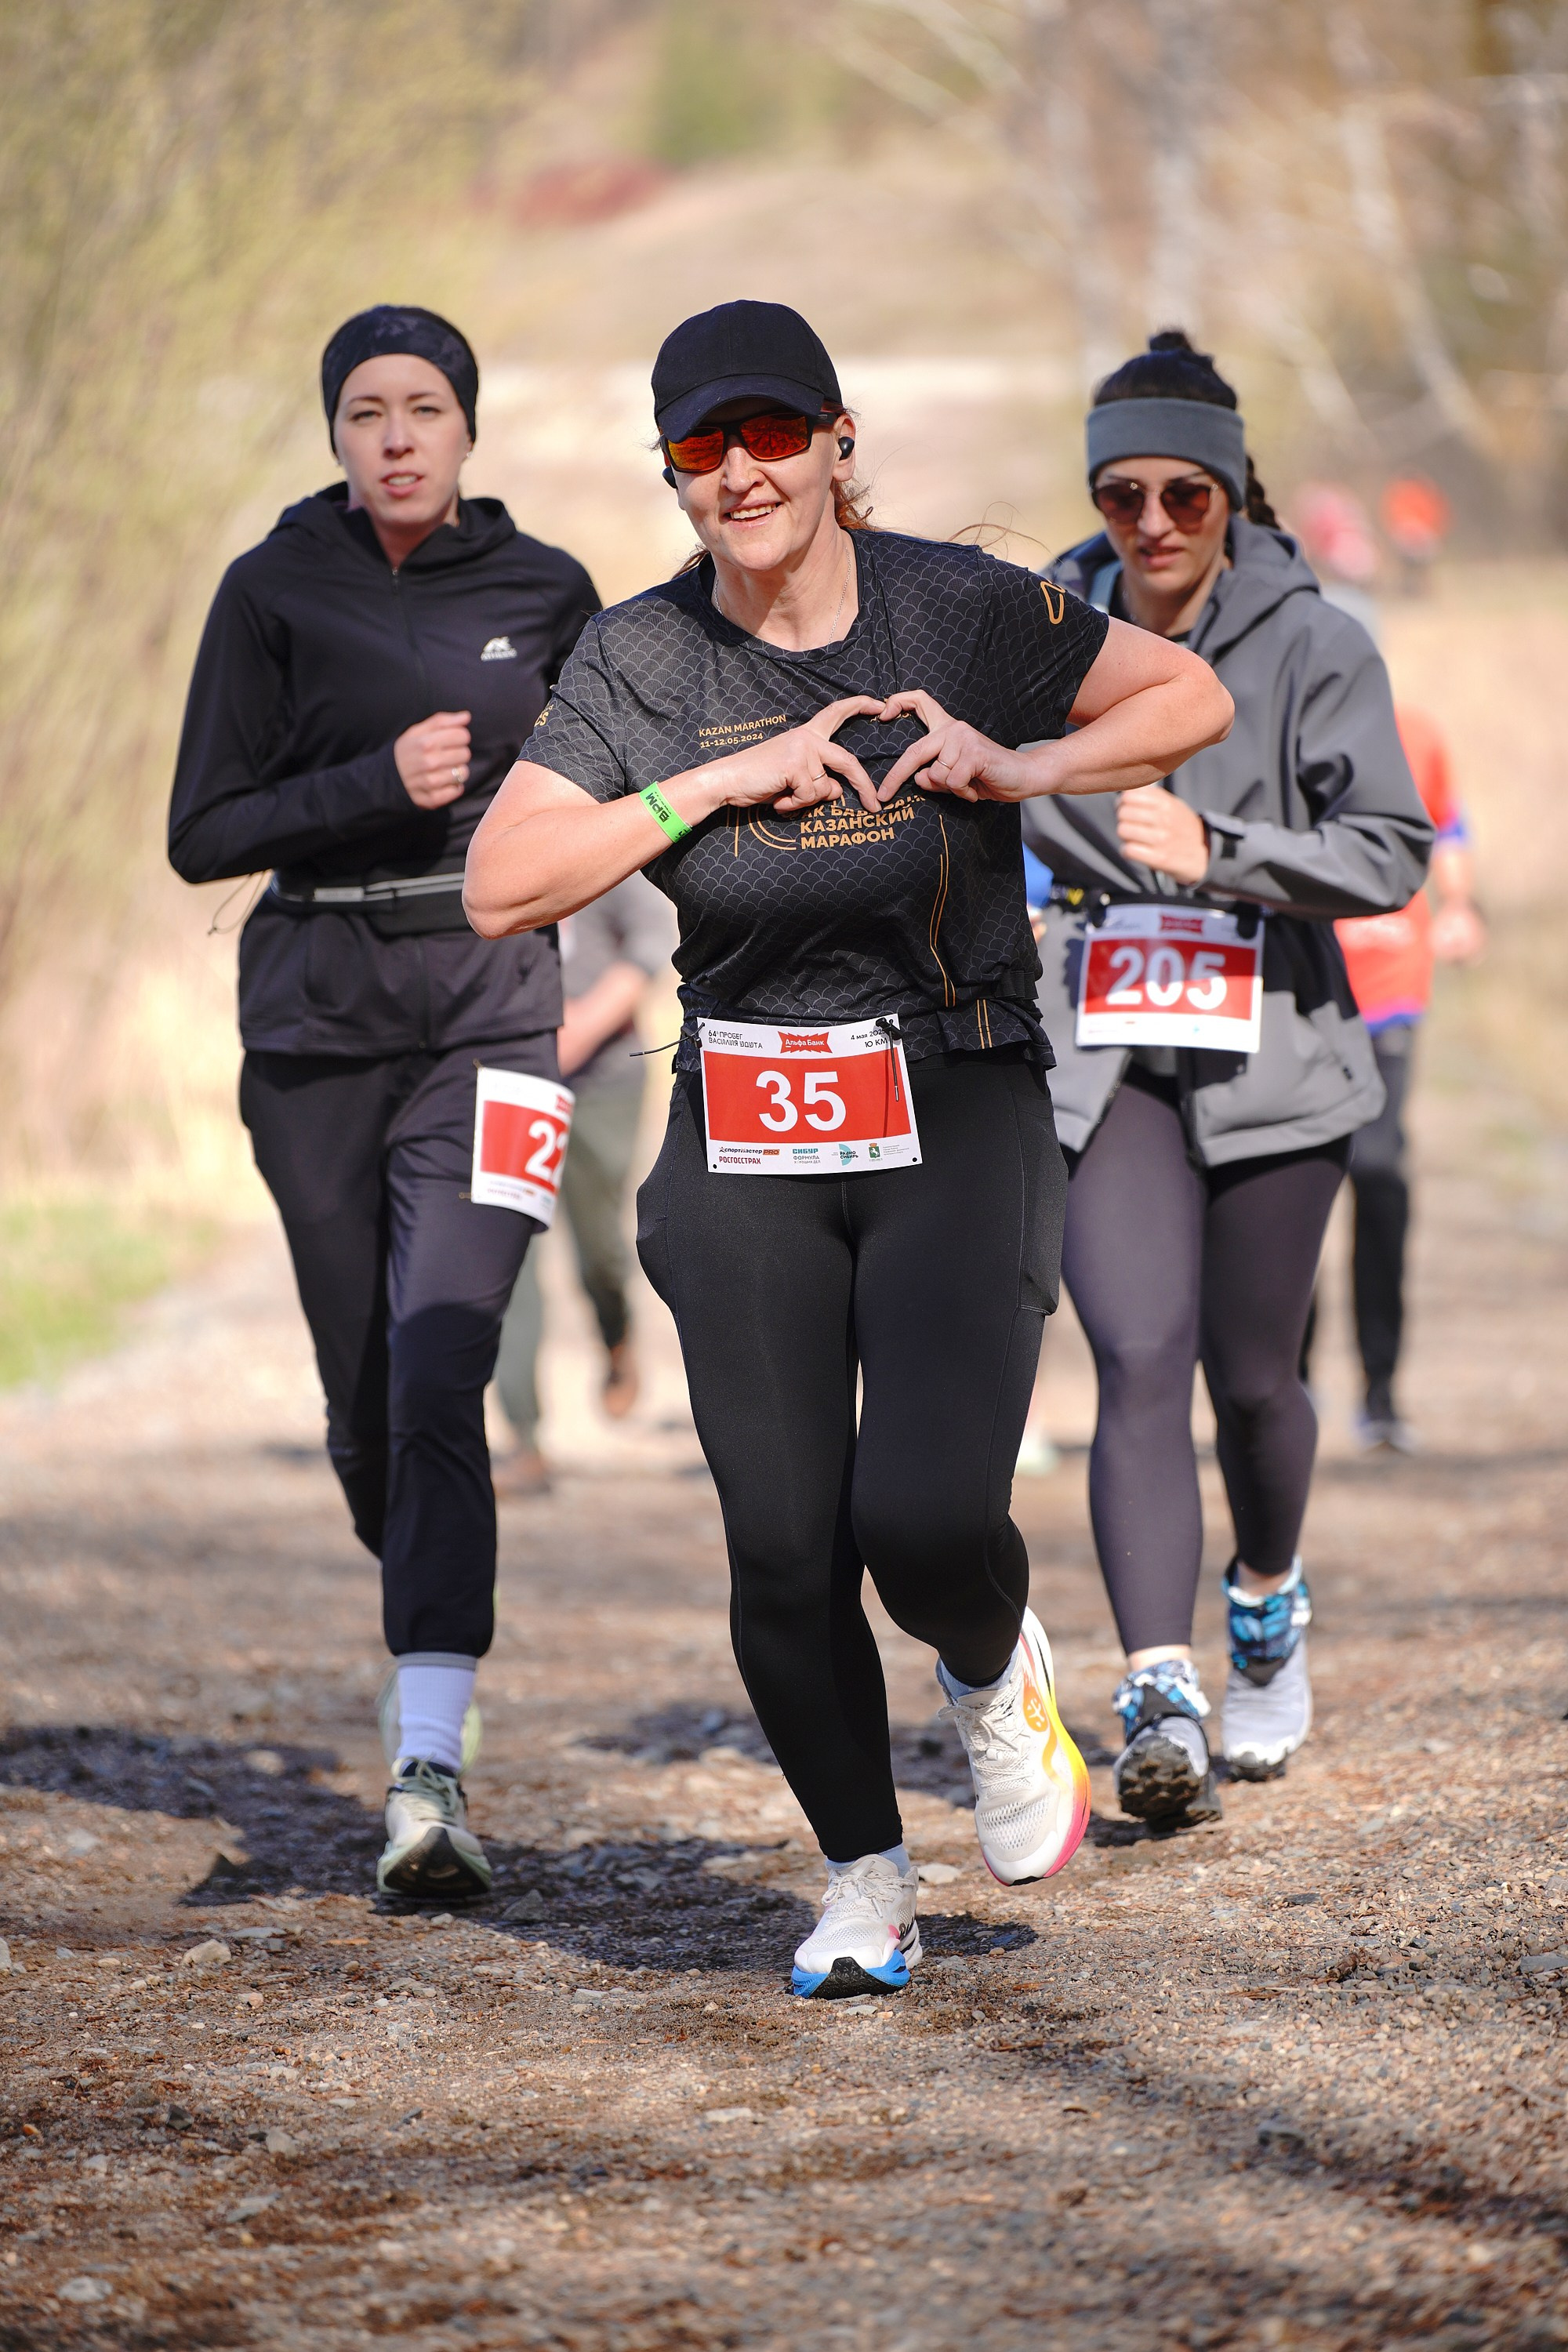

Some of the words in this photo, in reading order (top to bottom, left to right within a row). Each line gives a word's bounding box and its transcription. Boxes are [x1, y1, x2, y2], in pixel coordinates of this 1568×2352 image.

[699, 725, 732, 737] KAZAN
[734, 714, 786, 732] MARATHON
[700, 733, 764, 749] 11-12.05.2024
[800, 804, 915, 834] КАЗАНСКИЙ
[800, 826, 895, 850] МАРАФОН
[1105, 946, 1228, 1011] 205
[719, 1031, 742, 1040] ПРОБЕГ
[869, 1029, 885, 1037] 202
[708, 1036, 739, 1047] ВАСИЛИЯ
[786, 1039, 807, 1047] Альфа
[875, 1037, 888, 1046] КМ
[756, 1070, 847, 1132] 35
[719, 1156, 761, 1165] РОСГОССТРАХ
